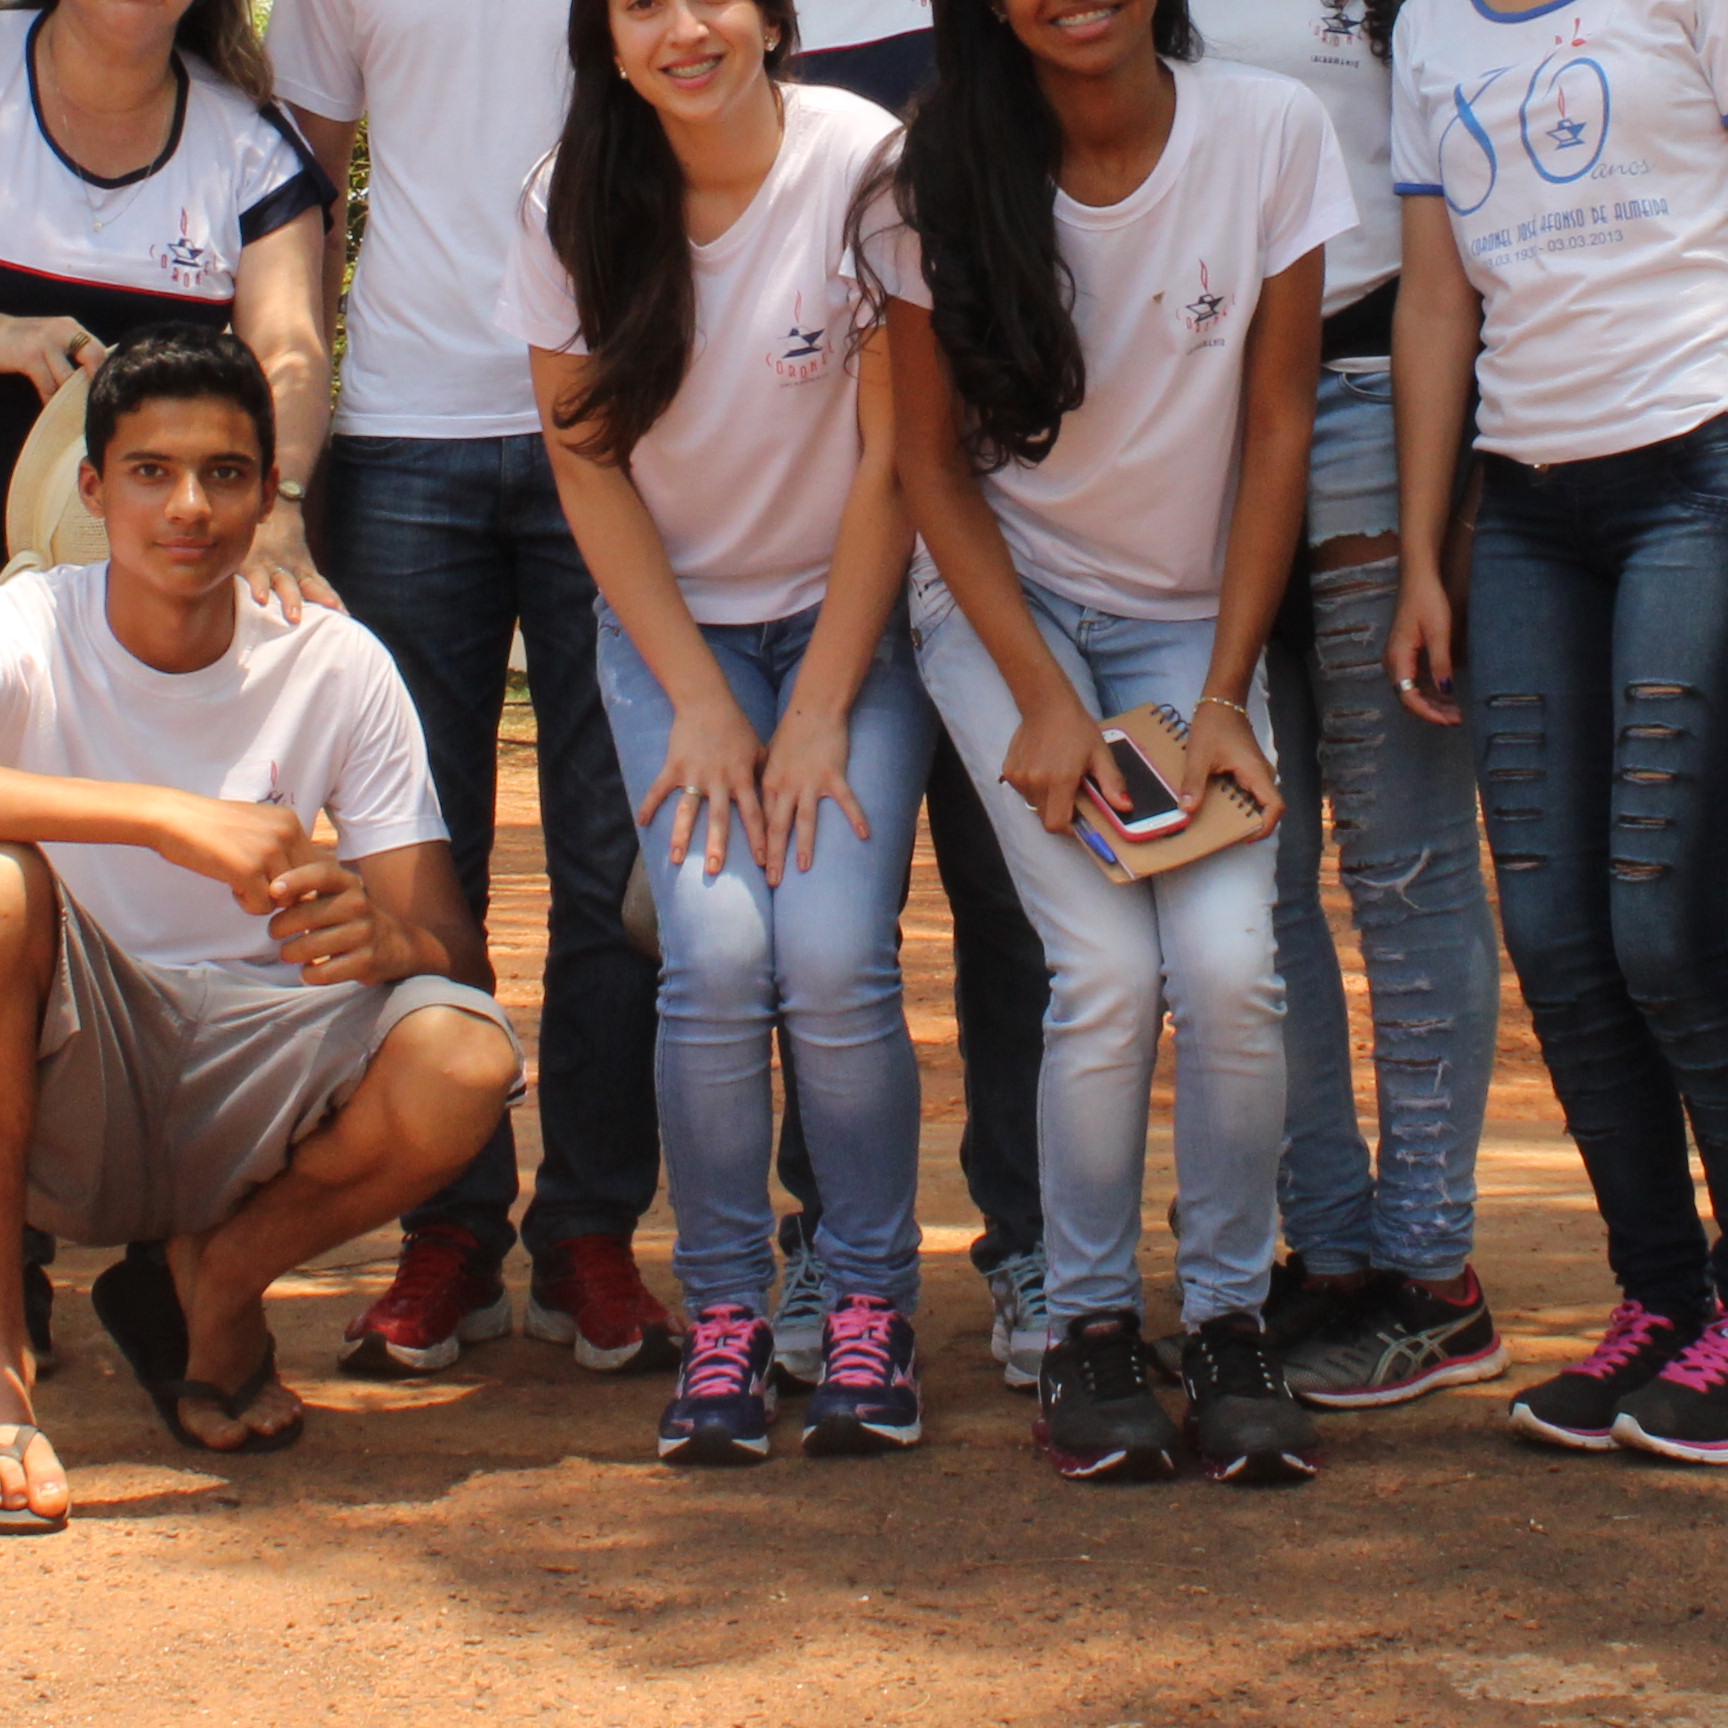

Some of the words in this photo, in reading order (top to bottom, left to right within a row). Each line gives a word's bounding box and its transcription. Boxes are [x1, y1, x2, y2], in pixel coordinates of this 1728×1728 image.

[1591, 159, 1651, 180] anos
[1516, 213, 1537, 244] JOSÉ
[1540, 208, 1585, 233] AFONSO
[1592, 204, 1608, 225] DE
[1614, 198, 1670, 222] ALMEIDA
[1547, 229, 1624, 253] 03.03.2013
